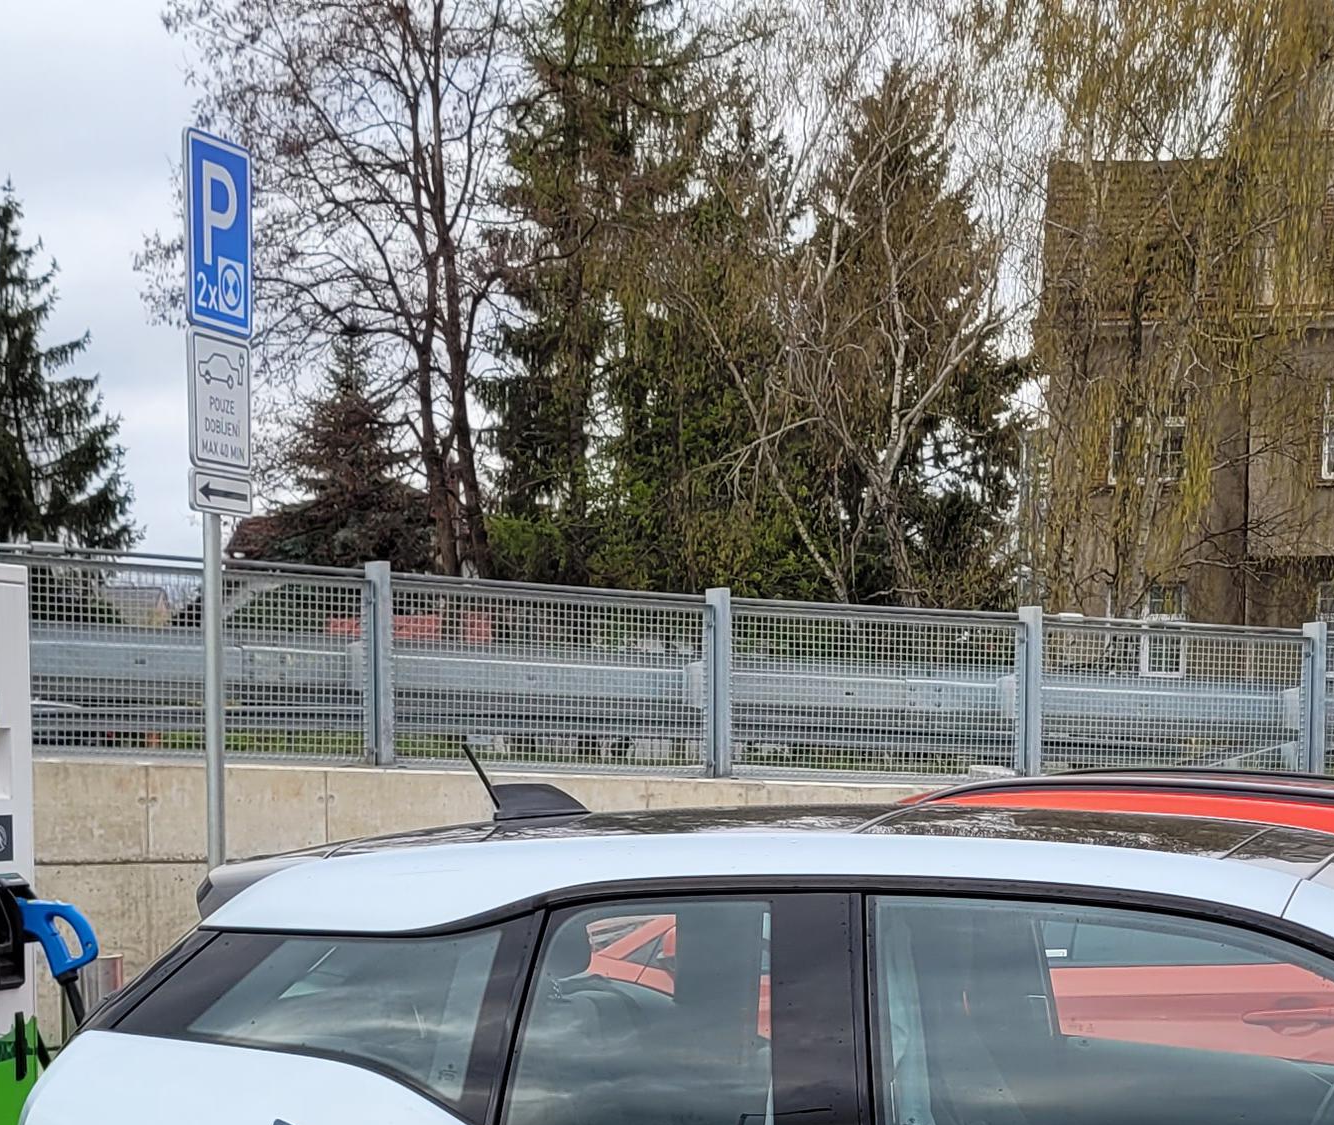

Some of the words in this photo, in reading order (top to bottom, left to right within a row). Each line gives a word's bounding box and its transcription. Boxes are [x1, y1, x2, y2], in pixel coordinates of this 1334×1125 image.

[202, 159, 238, 266] P
[197, 271, 219, 311] 2x
[209, 395, 235, 416] POUZE
[202, 439, 219, 457] MAX
[230, 445, 245, 461] MIN
